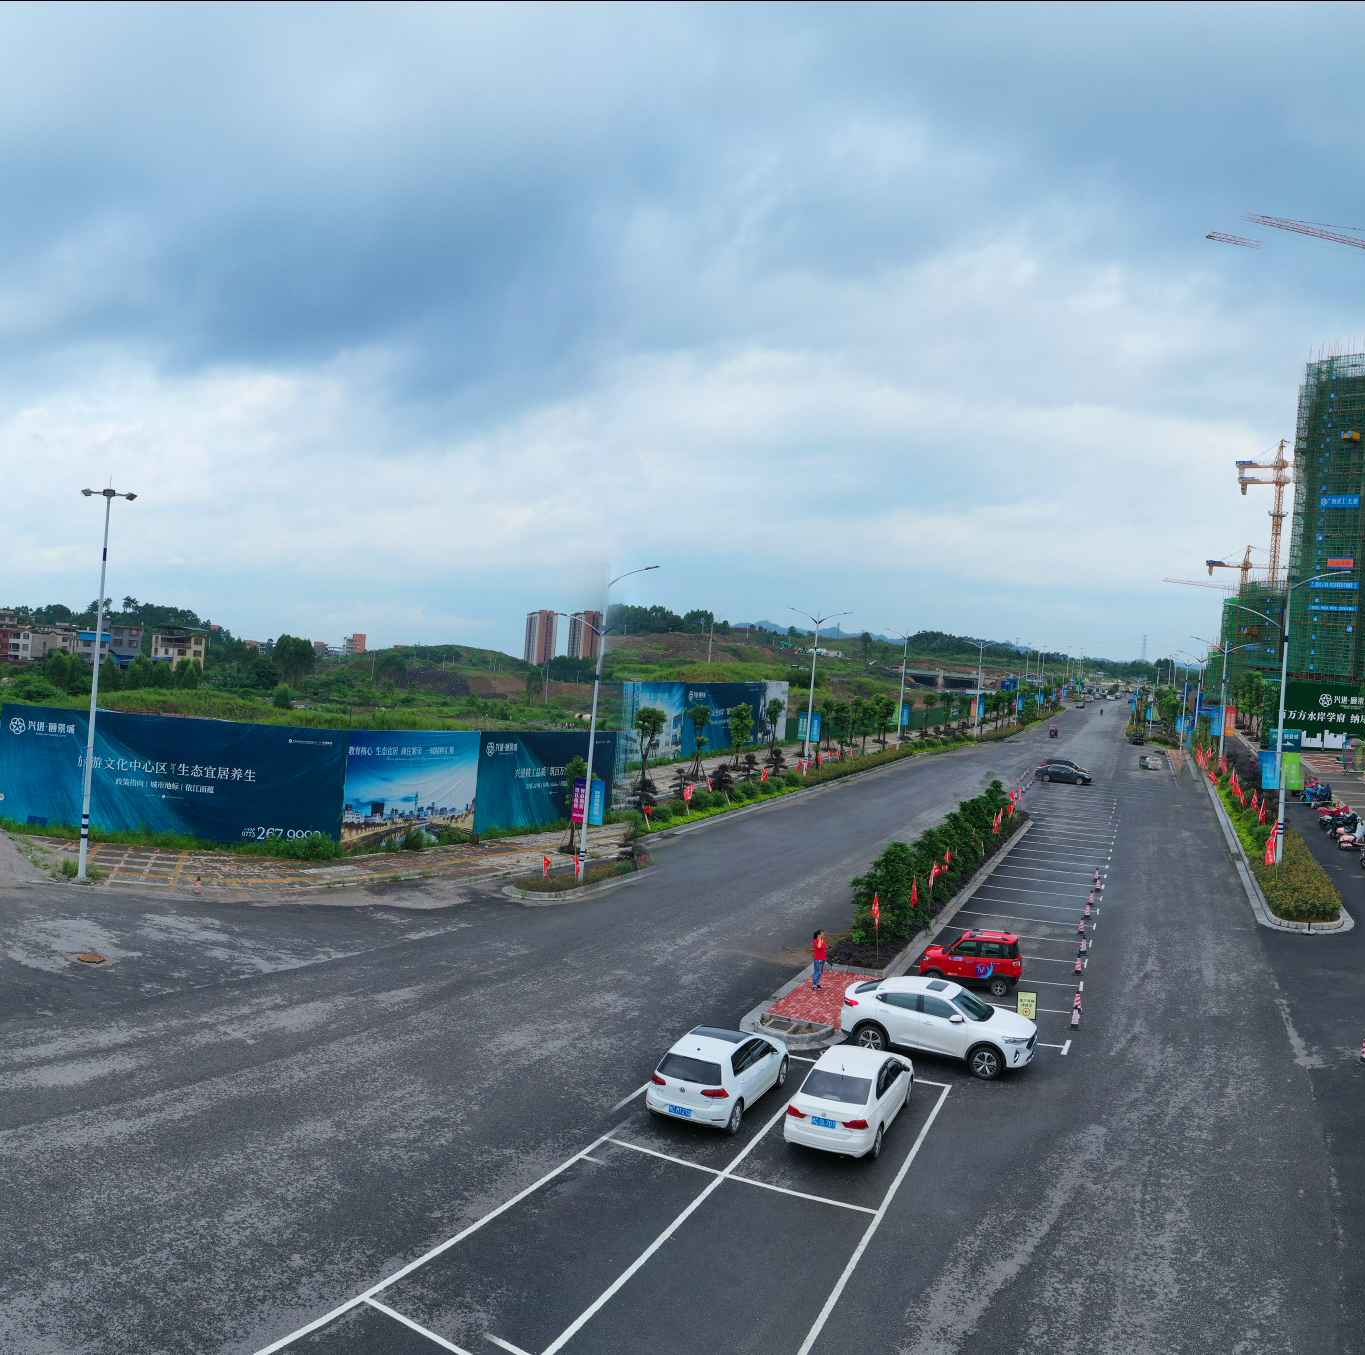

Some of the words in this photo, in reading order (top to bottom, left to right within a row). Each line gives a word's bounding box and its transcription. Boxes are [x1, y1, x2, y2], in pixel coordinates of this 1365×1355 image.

[177, 763, 256, 782] 生态宜居养生
